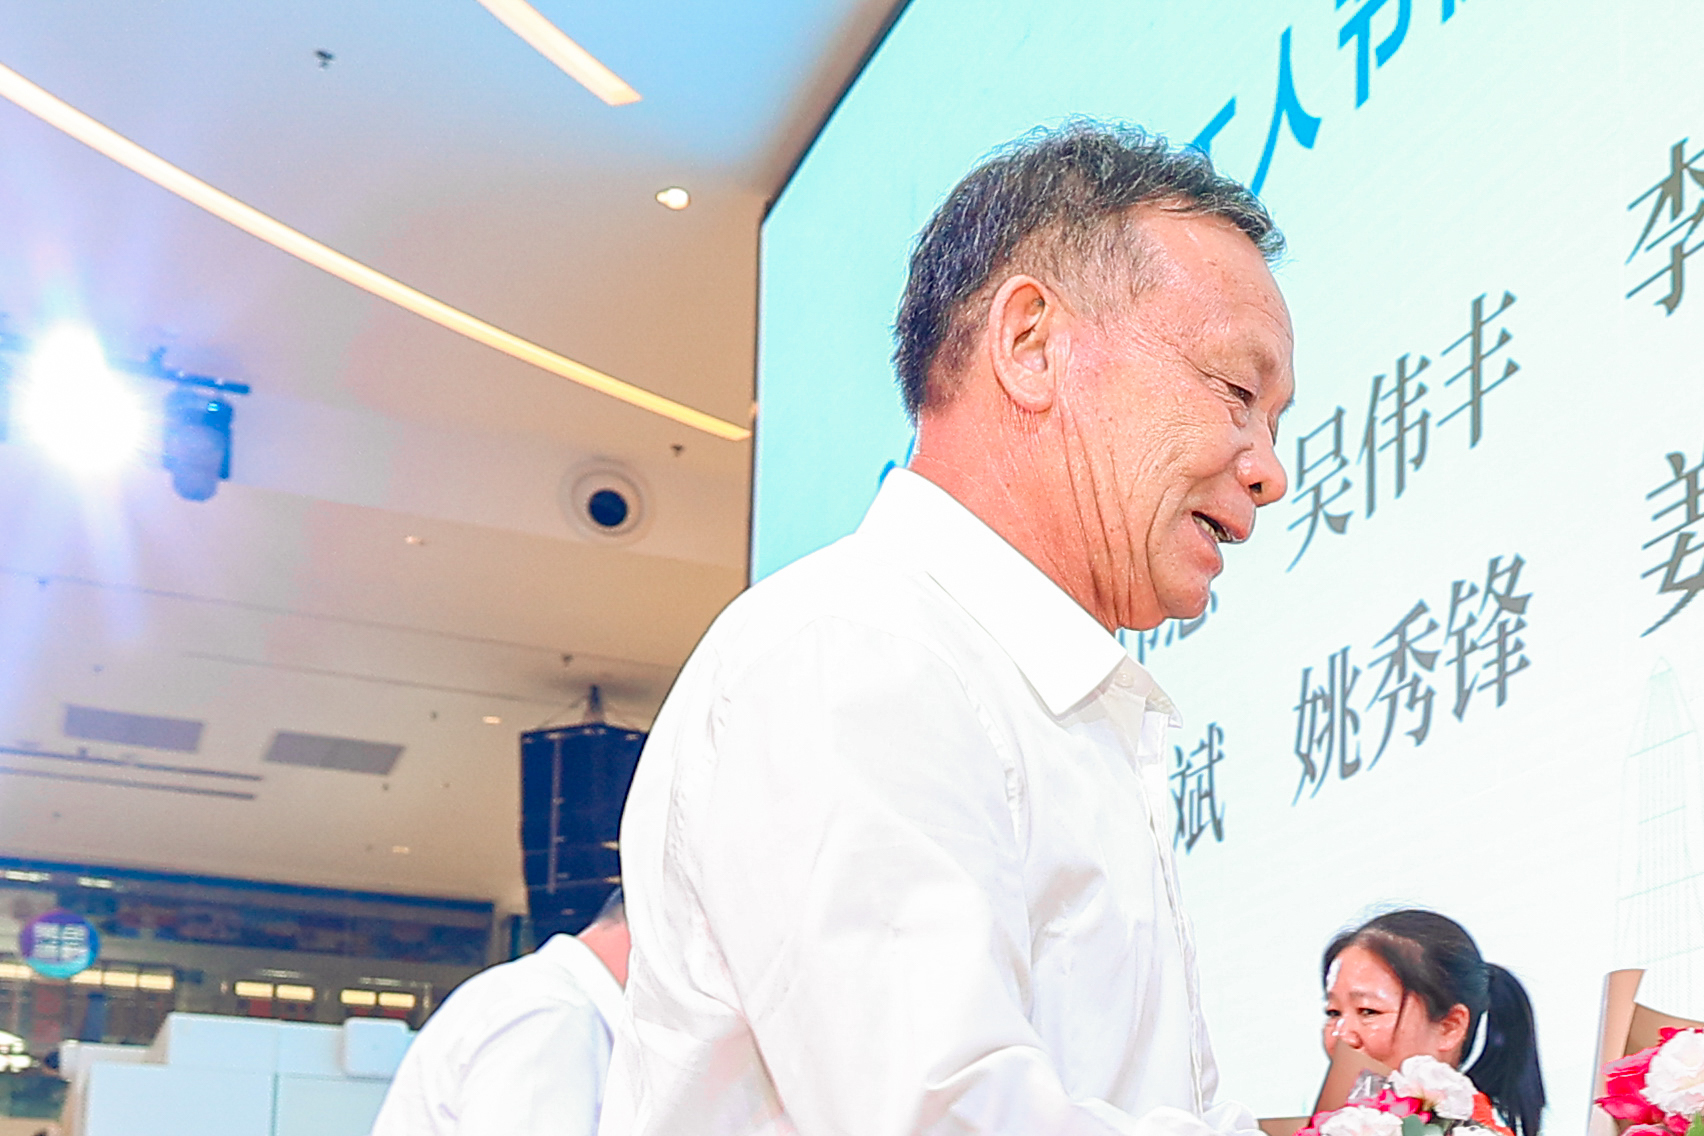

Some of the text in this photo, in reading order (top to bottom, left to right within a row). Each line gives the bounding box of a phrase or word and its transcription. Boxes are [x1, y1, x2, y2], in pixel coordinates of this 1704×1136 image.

[1286, 289, 1521, 573] 吴伟丰
[1291, 553, 1534, 807] 姚秀锋
